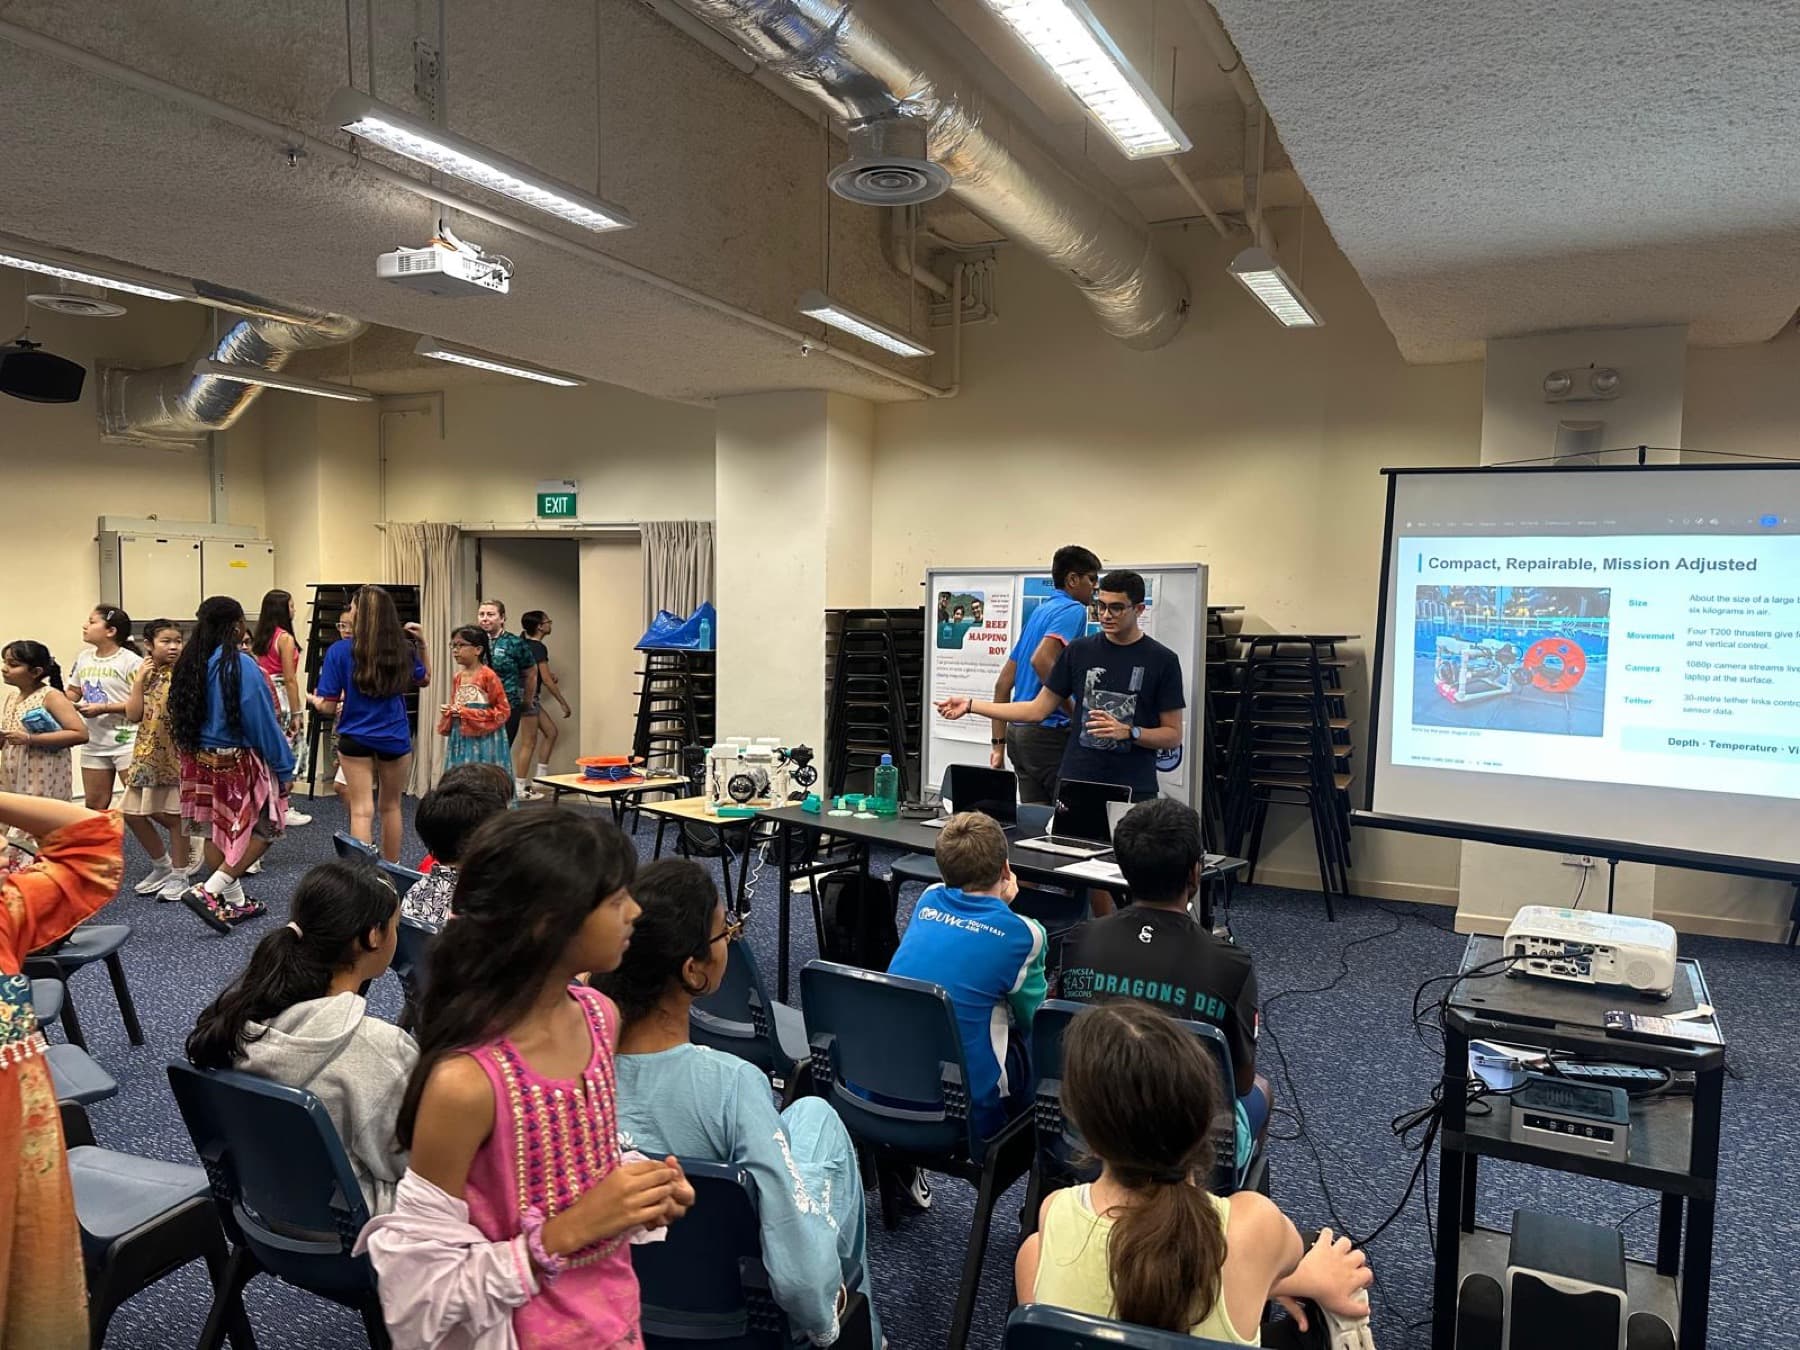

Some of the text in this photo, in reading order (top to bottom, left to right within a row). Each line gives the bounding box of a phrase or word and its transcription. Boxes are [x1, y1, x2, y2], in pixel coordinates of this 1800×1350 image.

[545, 497, 568, 513] EXIT
[1428, 557, 1758, 574] Compact, Repairable, Mission Adjusted
[1689, 594, 1714, 602] About
[1732, 595, 1750, 603] size
[1752, 595, 1762, 603] of
[1772, 595, 1794, 605] large
[1702, 607, 1744, 616] kilograms
[985, 620, 1008, 629] REEF
[1626, 631, 1675, 640] Movement
[1687, 627, 1707, 635] Four
[1710, 628, 1732, 636] T200
[1734, 628, 1772, 638] thrusters
[1774, 631, 1793, 639] give
[1705, 640, 1736, 648] vertical
[989, 646, 1007, 655] ROV
[1625, 664, 1660, 673] Camera
[1686, 660, 1712, 670] 1080p
[1714, 663, 1747, 671] camera
[1749, 664, 1784, 672] streams
[1684, 673, 1711, 682] laptop
[1723, 675, 1737, 683] the
[1624, 696, 1653, 705] Tether
[1724, 696, 1748, 704] tether
[1751, 697, 1771, 706] links
[1668, 737, 1700, 748] Depth
[1709, 740, 1778, 753] Temperature
[935, 911, 966, 928] UWC
[1094, 973, 1227, 1020] DRAGONS DEN
